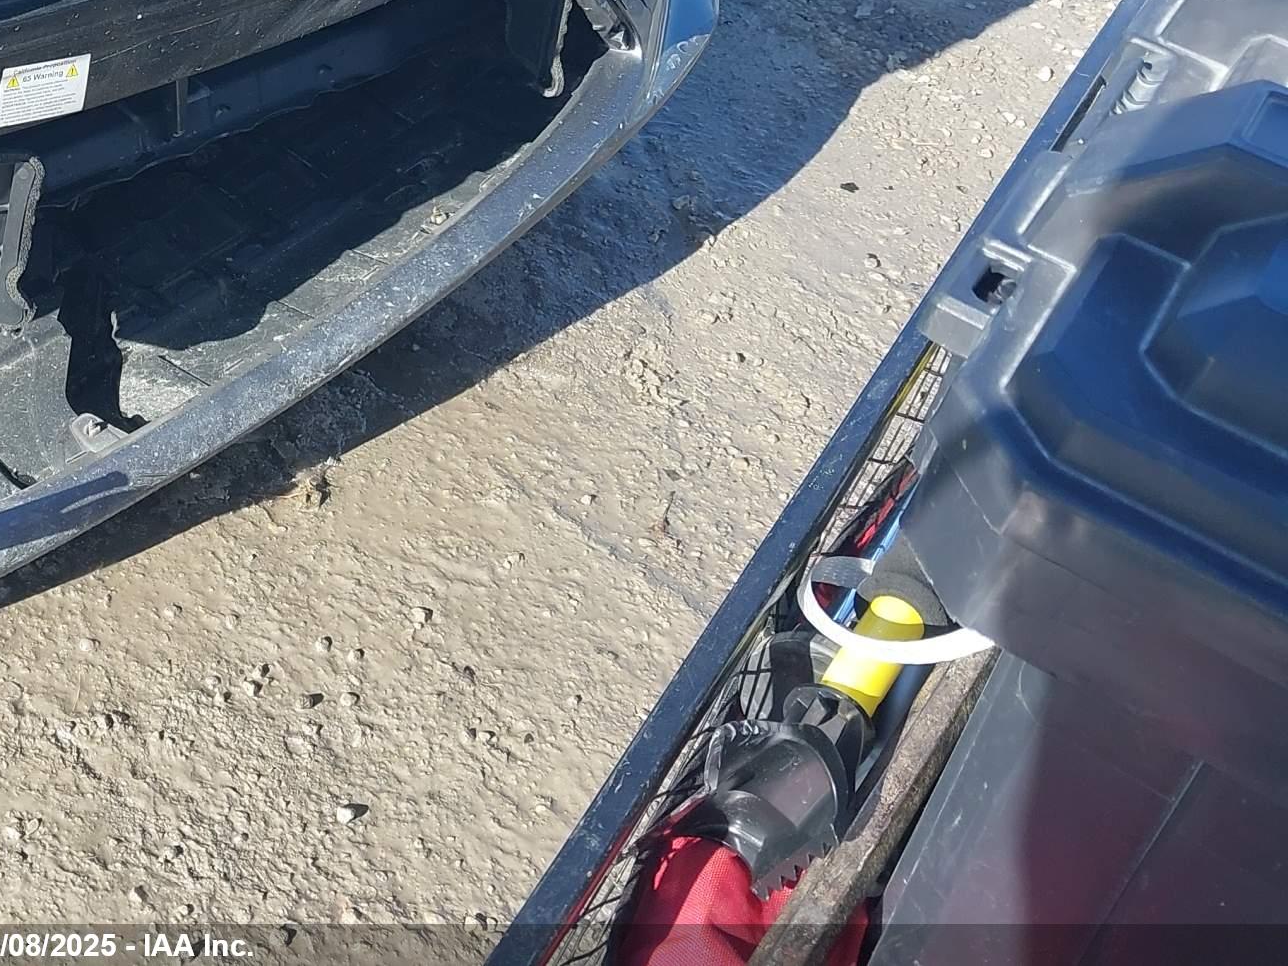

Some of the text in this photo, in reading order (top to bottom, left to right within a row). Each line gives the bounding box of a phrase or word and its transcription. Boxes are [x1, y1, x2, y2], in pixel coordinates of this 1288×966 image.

[14, 66, 41, 75] California
[22, 70, 64, 83] 65 Warning
